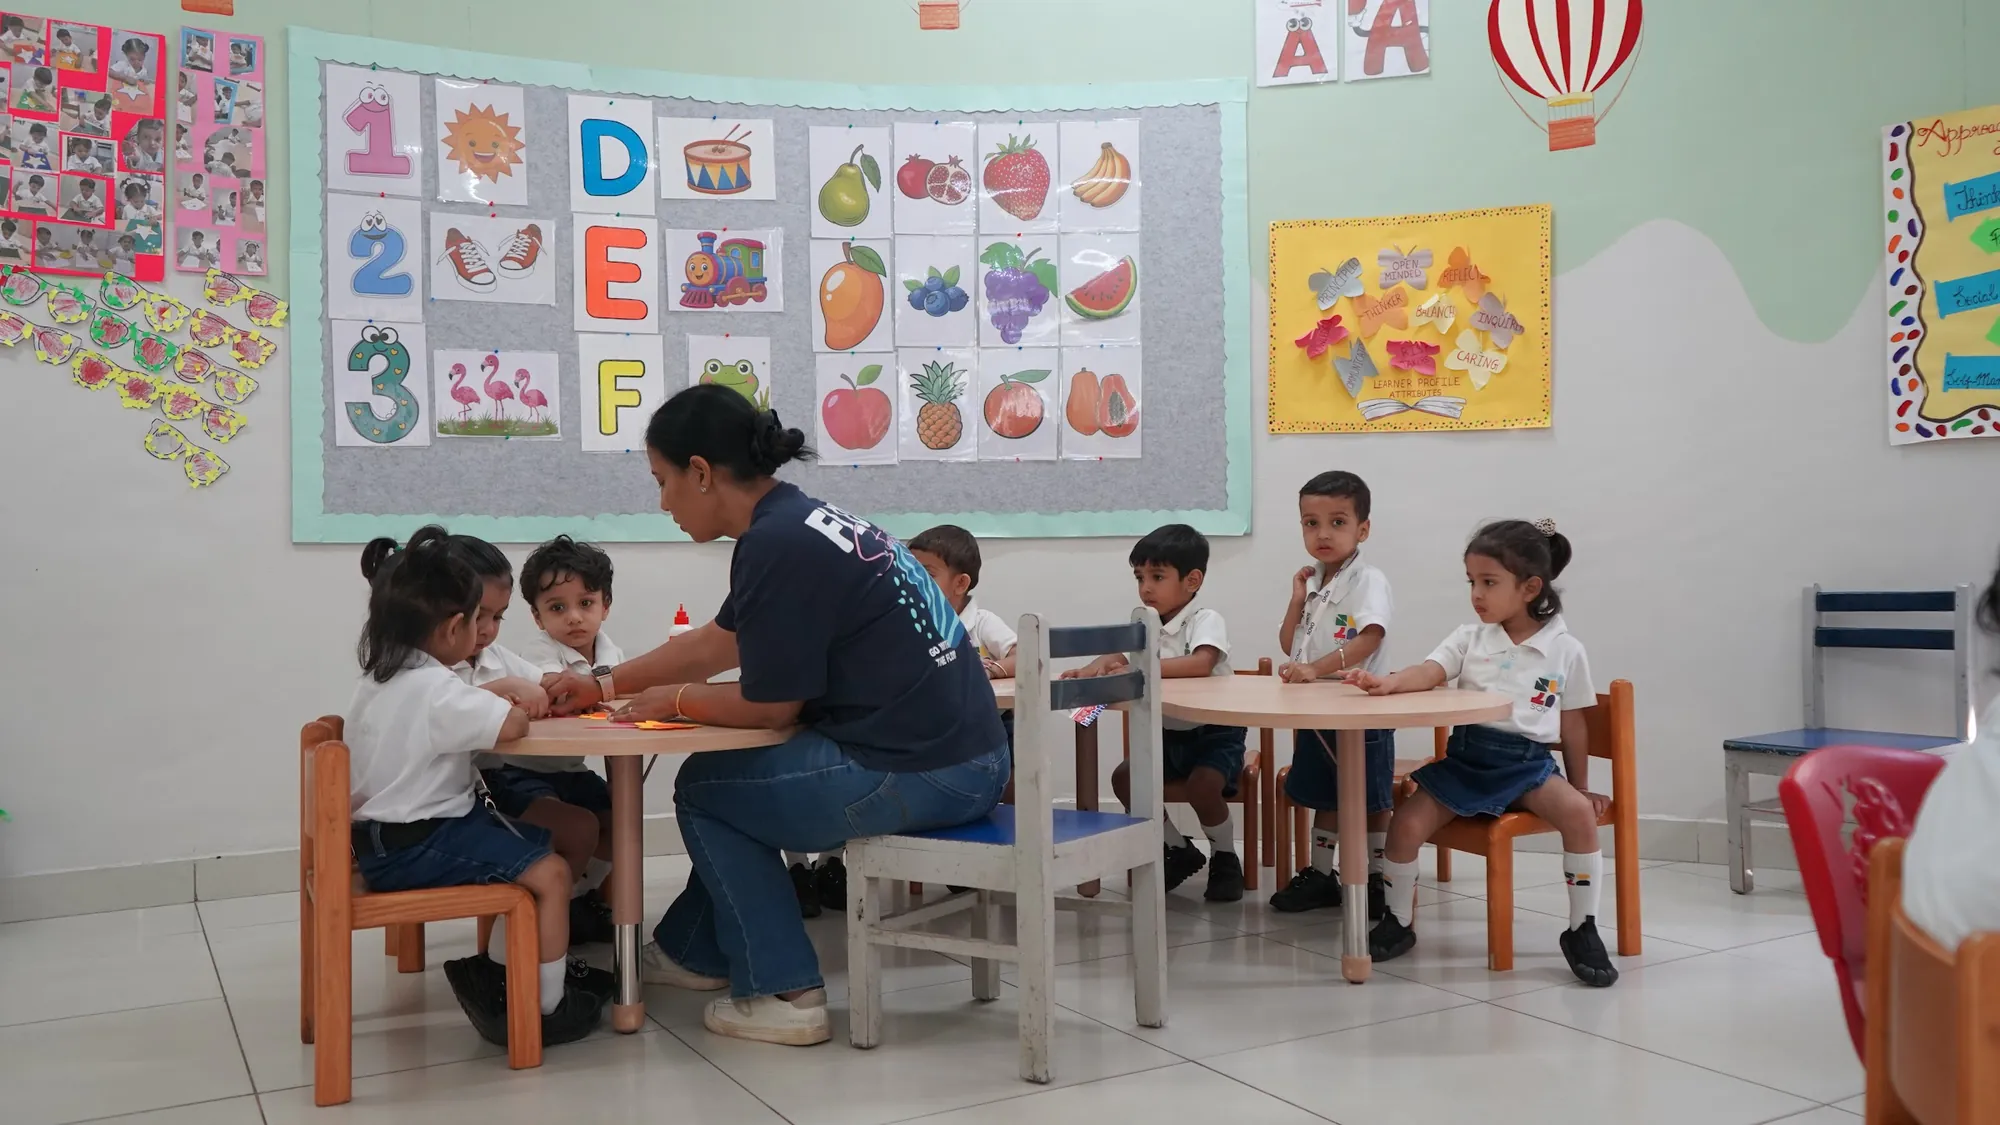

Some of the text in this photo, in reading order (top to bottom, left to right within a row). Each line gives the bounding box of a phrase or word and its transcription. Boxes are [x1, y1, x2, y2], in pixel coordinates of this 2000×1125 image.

[1272, 29, 1328, 78] A
[1363, 0, 1429, 76] A
[344, 98, 414, 178] 1
[580, 118, 648, 196] D
[349, 226, 414, 297] 2
[585, 225, 648, 320] E
[1384, 269, 1422, 281] MINDED
[1391, 260, 1420, 271] OPEN
[1364, 293, 1403, 320] THINKER
[1953, 283, 1998, 307] Social
[1456, 350, 1499, 371] CARING
[345, 337, 419, 443] 3
[598, 359, 646, 436] F
[1373, 377, 1461, 389] LEARNER PROFILE
[1389, 389, 1442, 398] ATTRIBUTES
[928, 645, 941, 657] GO
